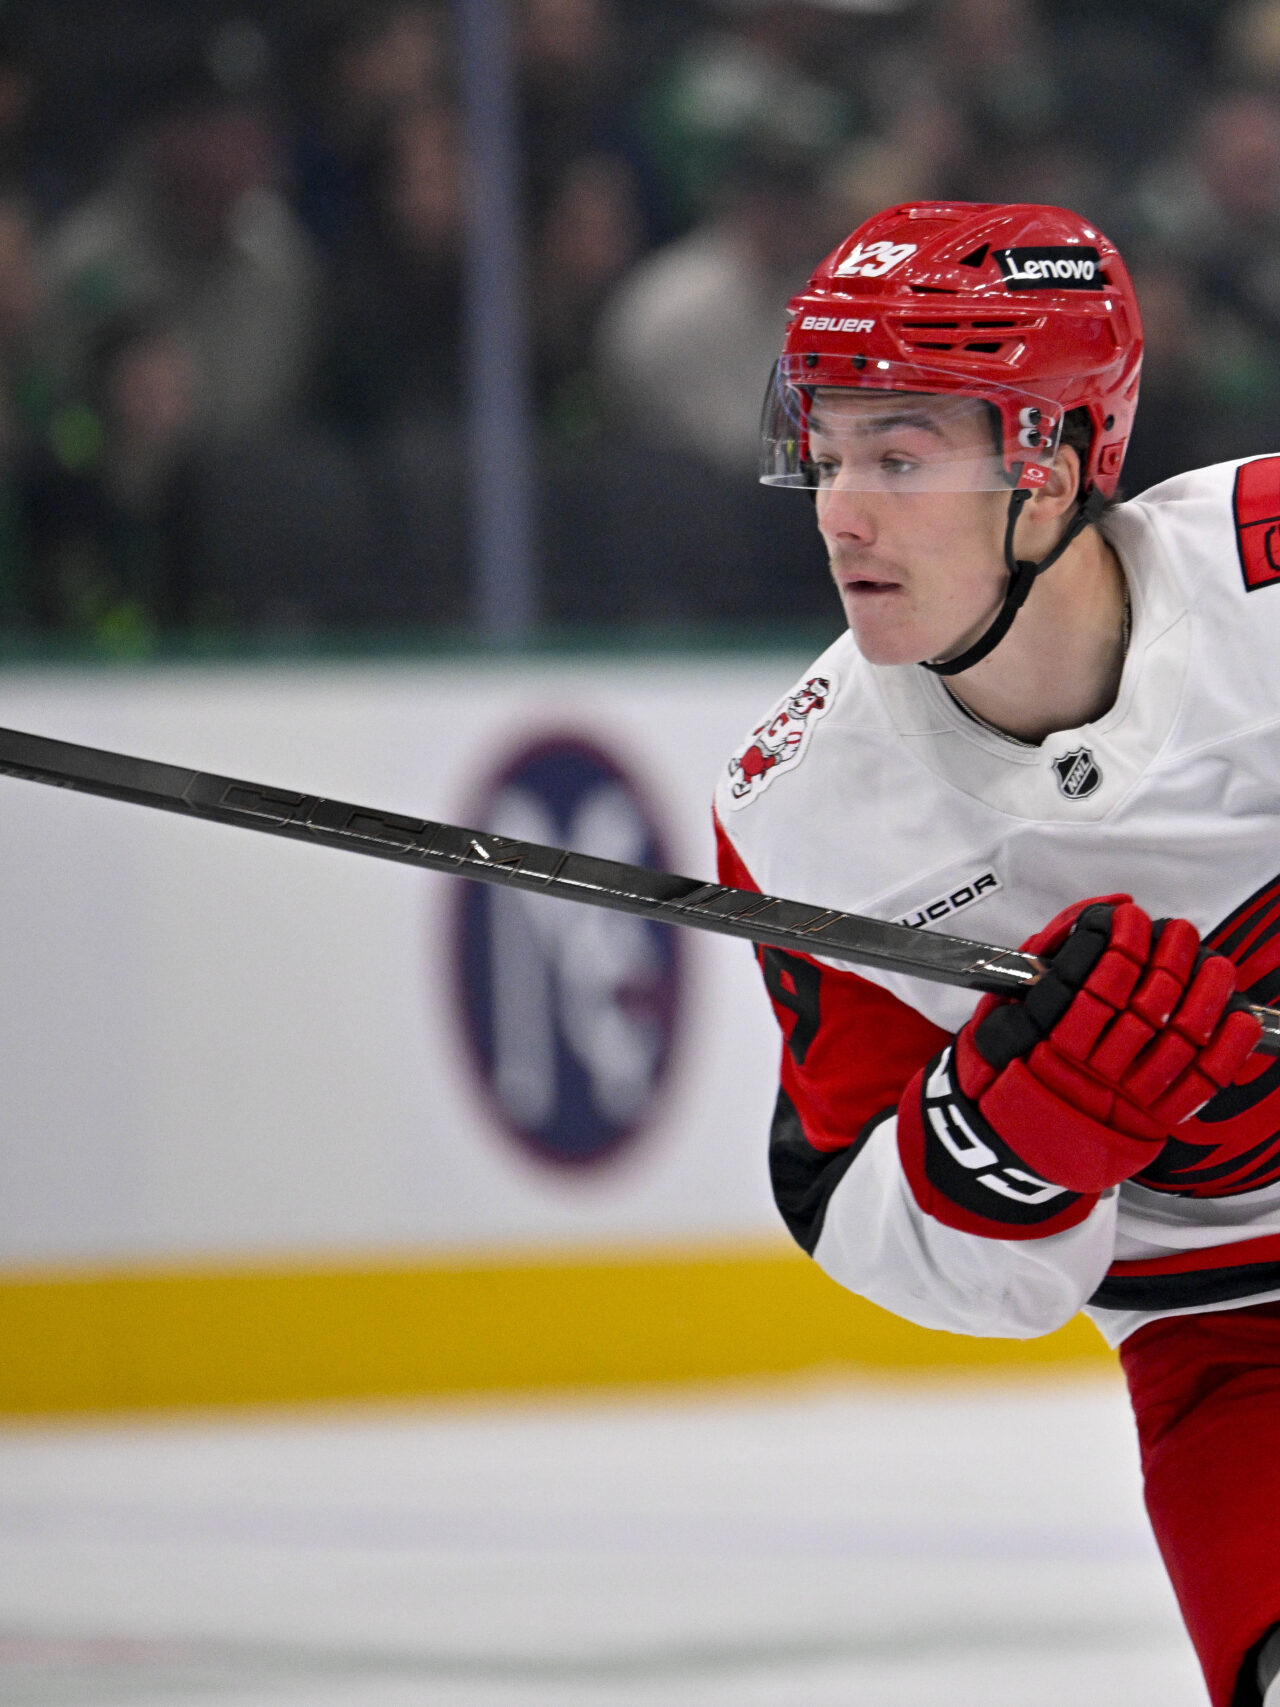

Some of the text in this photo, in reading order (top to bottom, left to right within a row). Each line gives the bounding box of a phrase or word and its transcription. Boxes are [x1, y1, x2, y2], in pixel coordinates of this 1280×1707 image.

[834, 241, 918, 278] 29
[1004, 250, 1095, 281] Lenovo
[1067, 758, 1090, 794] NHL
[894, 873, 998, 928] UCOR
